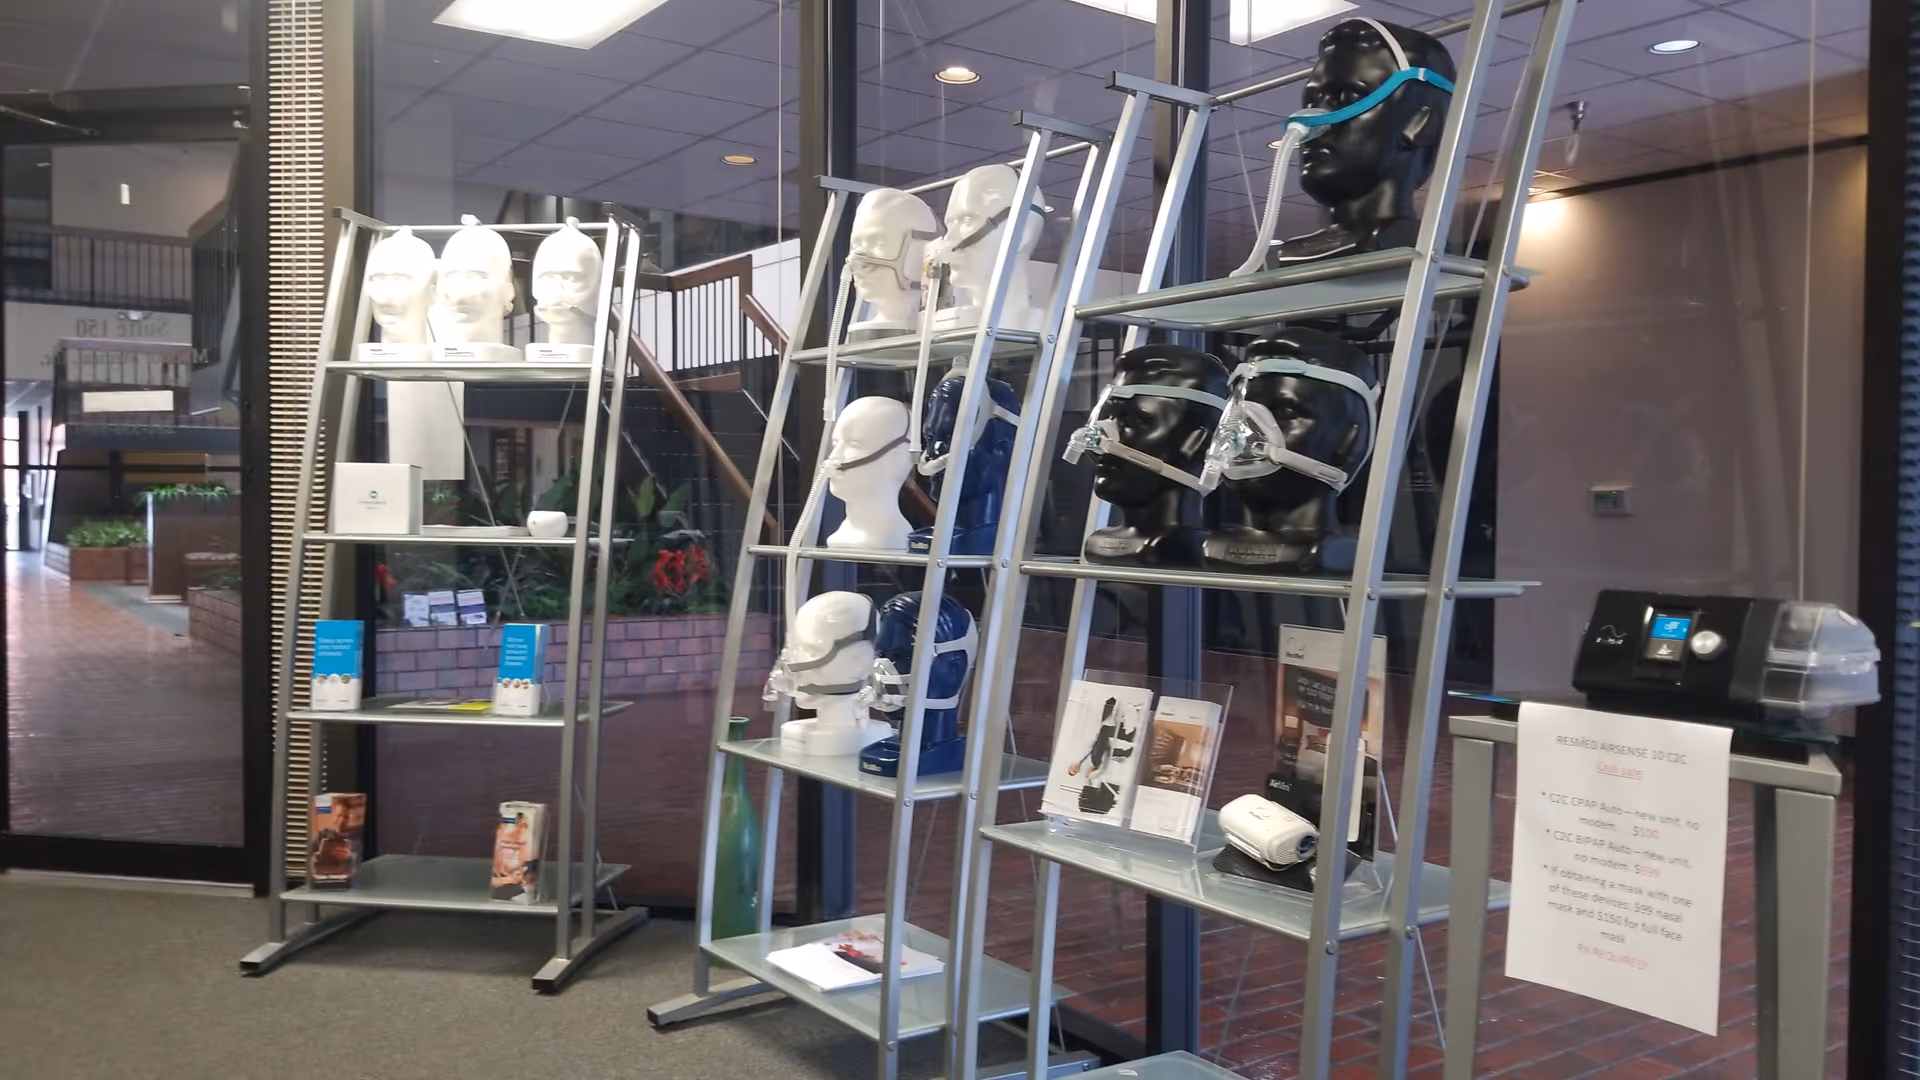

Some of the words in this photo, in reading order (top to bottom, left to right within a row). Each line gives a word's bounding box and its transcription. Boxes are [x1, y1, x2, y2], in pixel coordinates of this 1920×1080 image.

[1556, 735, 1598, 750] RESMED
[1600, 742, 1648, 760] AIRSENSE
[1650, 750, 1664, 760] 10
[1550, 793, 1570, 805] C2C
[1571, 796, 1598, 808] CPAP
[1600, 802, 1624, 816] Auto
[1634, 811, 1657, 822] new
[1686, 820, 1702, 831] no
[1554, 830, 1574, 842] C2C
[1608, 841, 1632, 855] Auto
[1643, 850, 1666, 862] new
[1574, 854, 1588, 862] no
[1549, 883, 1560, 892] of
[1562, 885, 1590, 900] these
[1655, 910, 1684, 922] nasal
[1560, 870, 1606, 889] obtaining
[1618, 882, 1644, 896] mask
[1647, 889, 1670, 903] with
[1672, 896, 1692, 908] one
[1548, 901, 1573, 912] mask
[1576, 906, 1595, 918] and
[1597, 911, 1622, 926] $150
[1624, 917, 1640, 928] for
[1642, 922, 1659, 934] full
[1660, 926, 1684, 942] face
